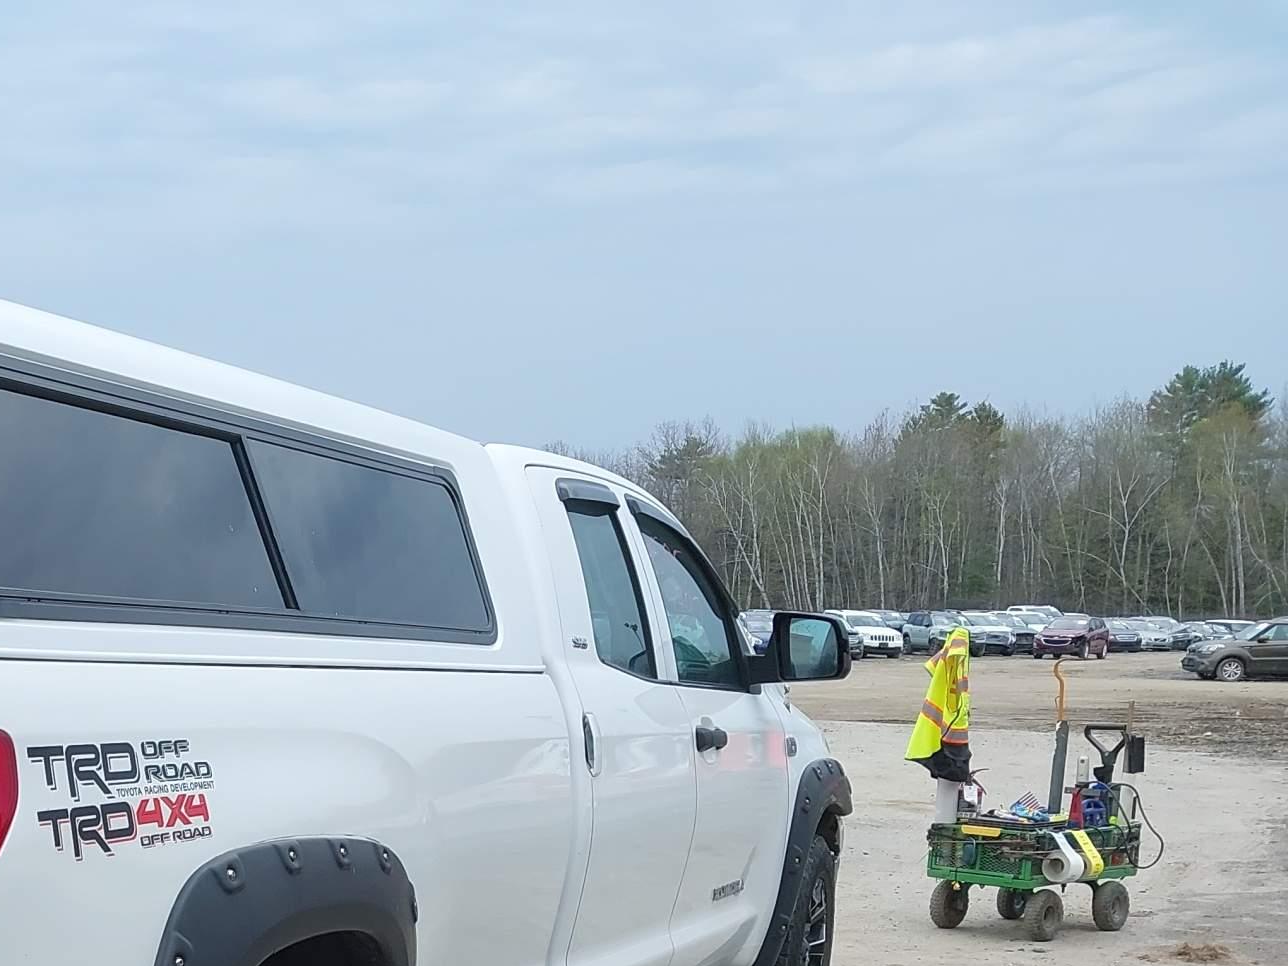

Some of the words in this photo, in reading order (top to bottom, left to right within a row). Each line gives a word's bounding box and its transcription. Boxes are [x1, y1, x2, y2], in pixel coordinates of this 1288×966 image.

[141, 740, 189, 759] OFF
[27, 743, 140, 802] TRD
[144, 762, 212, 783] ROAD
[116, 787, 142, 798] TOYOTA
[144, 784, 169, 795] RACING
[170, 781, 215, 793] DEVELOPMENT
[37, 802, 137, 861] TRD
[136, 793, 210, 828] 4X4
[140, 832, 171, 848] OFF
[173, 826, 212, 843] ROAD
